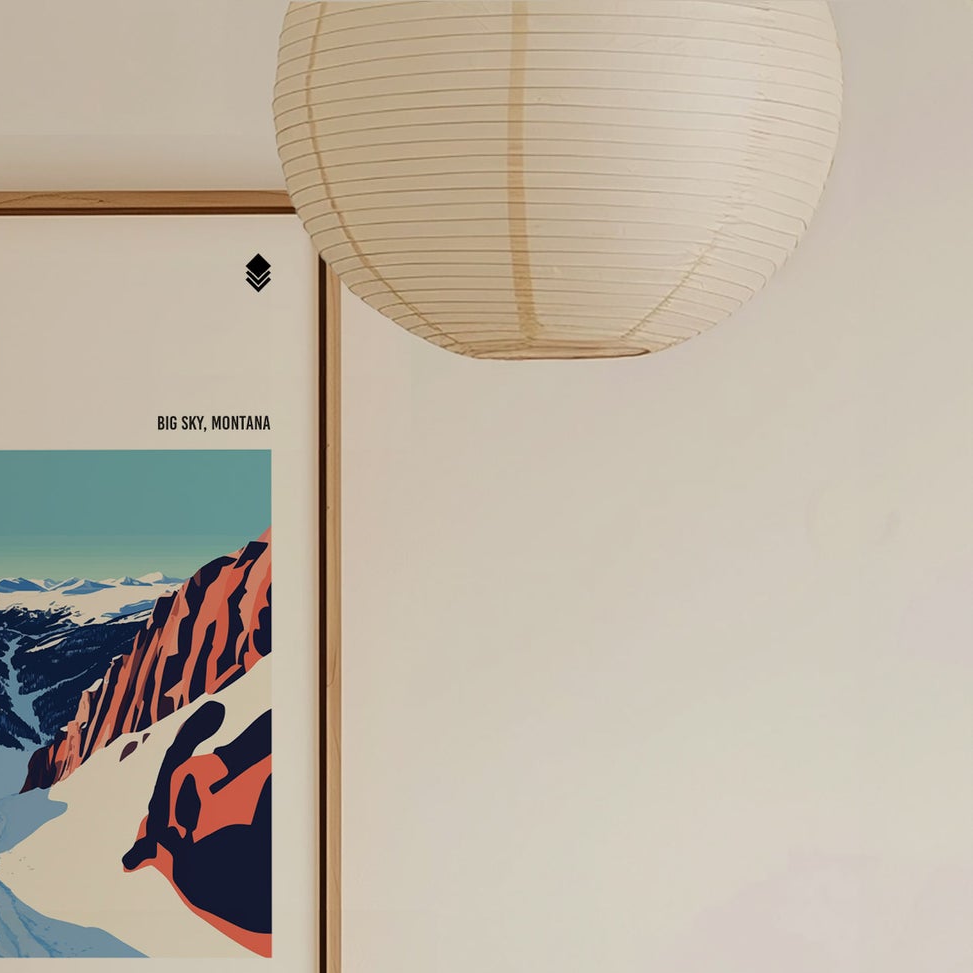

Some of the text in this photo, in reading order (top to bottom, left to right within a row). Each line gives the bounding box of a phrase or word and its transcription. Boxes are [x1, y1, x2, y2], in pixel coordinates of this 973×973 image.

[157, 415, 271, 433] BIG SKY, MONTANA
